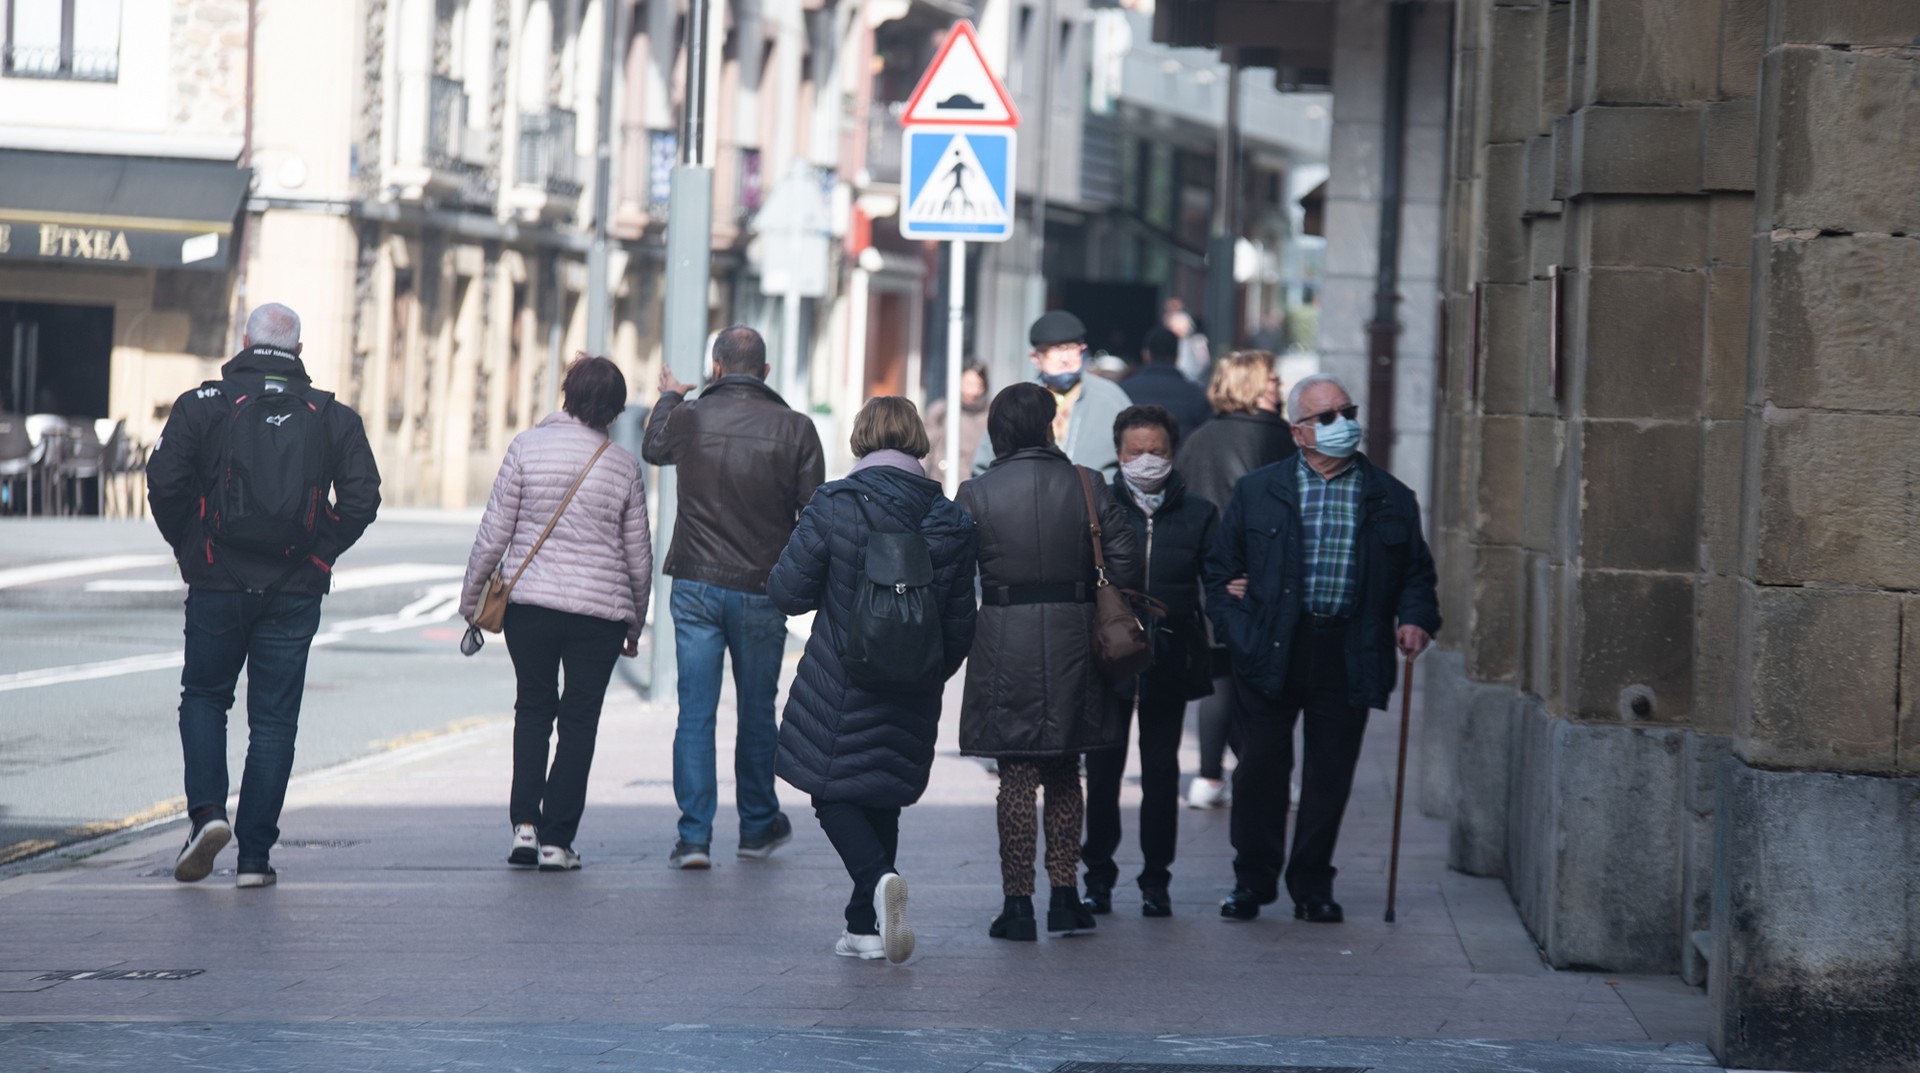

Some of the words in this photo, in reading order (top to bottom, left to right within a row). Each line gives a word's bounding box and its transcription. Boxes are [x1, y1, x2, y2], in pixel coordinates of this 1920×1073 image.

[39, 222, 131, 262] ETXEA
[253, 348, 273, 356] HELLY
[272, 350, 296, 361] HANSEN
